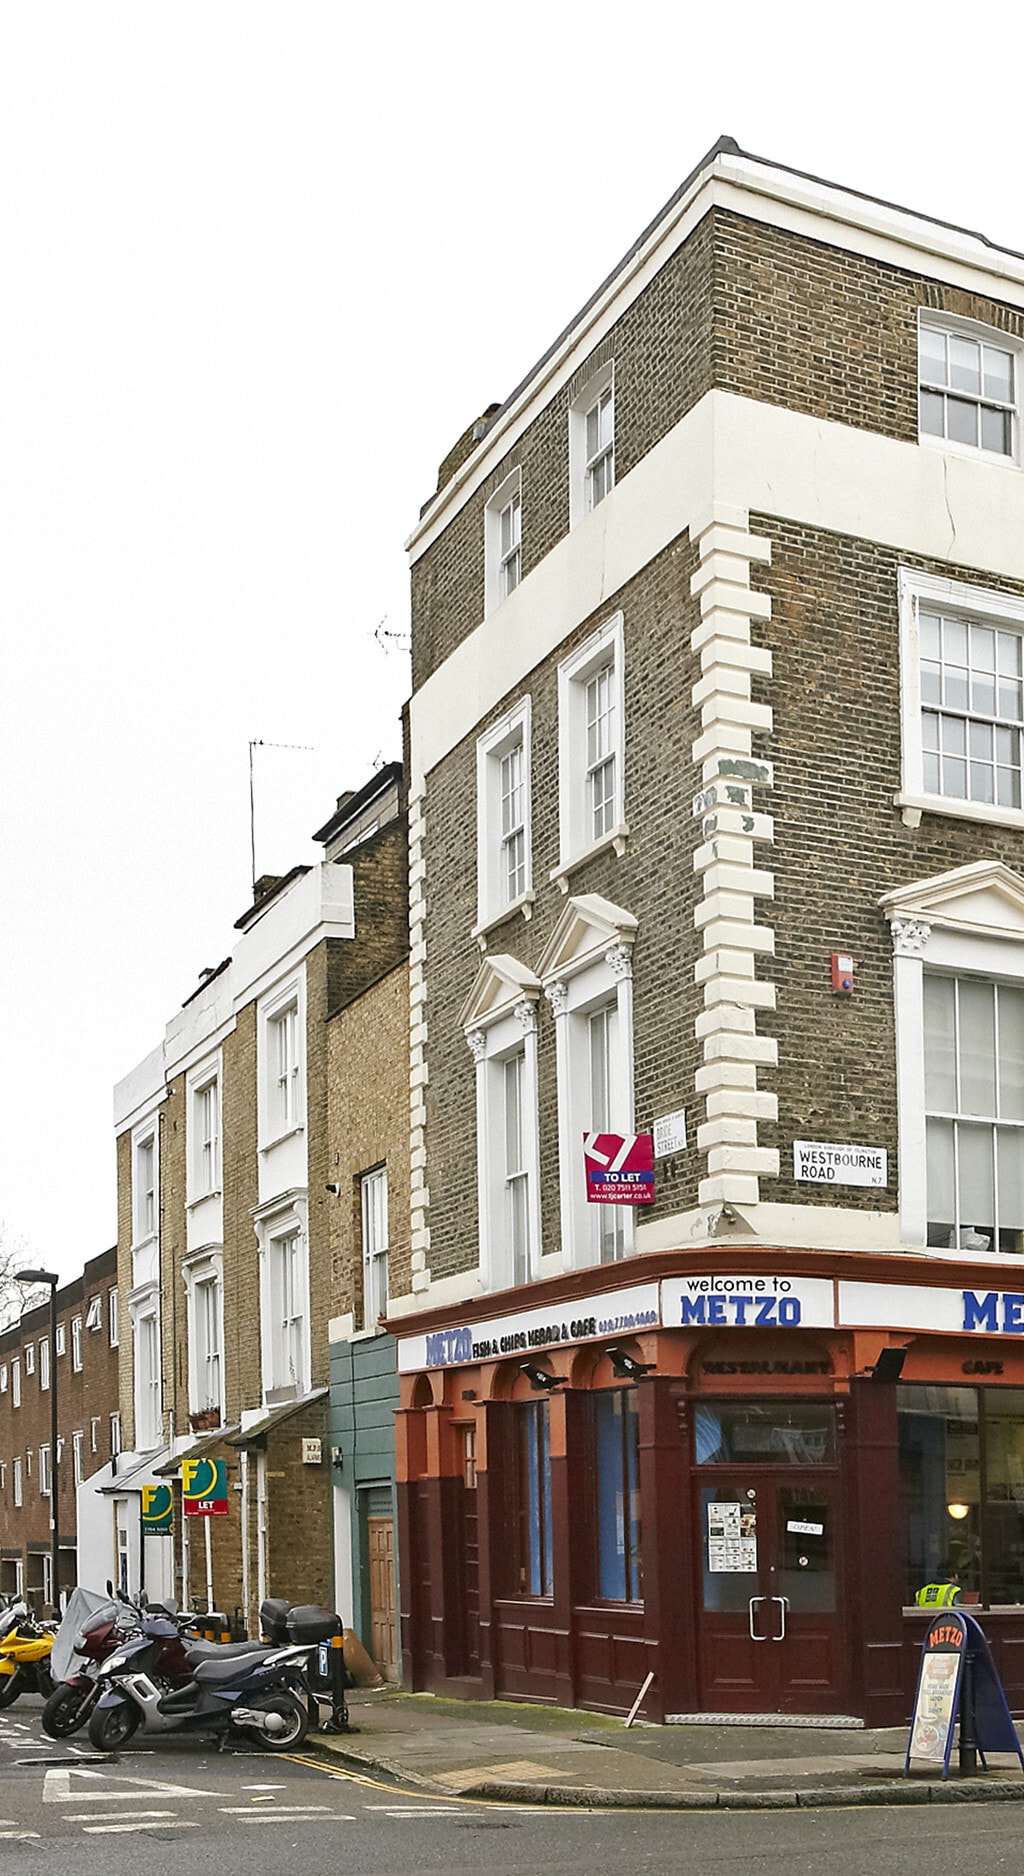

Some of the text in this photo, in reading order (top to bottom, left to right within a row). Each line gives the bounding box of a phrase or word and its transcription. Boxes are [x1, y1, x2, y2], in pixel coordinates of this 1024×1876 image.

[799, 1150, 882, 1169] WESTBOURNE
[604, 1173, 641, 1182] TO LET
[801, 1165, 835, 1180] ROAD
[686, 1276, 792, 1292] welcome to
[680, 1295, 801, 1326] METZO
[426, 1327, 473, 1366] METZO
[472, 1340, 491, 1359] FISH
[491, 1337, 499, 1354] &
[500, 1333, 527, 1353] CHIPS
[528, 1325, 561, 1347] KEBAB
[561, 1323, 569, 1340] &
[570, 1317, 597, 1338] CAFE
[962, 1360, 1004, 1375] CAFE
[198, 1501, 214, 1509] LET
[792, 1524, 816, 1532] OPEN
[929, 1626, 963, 1649] METZO
